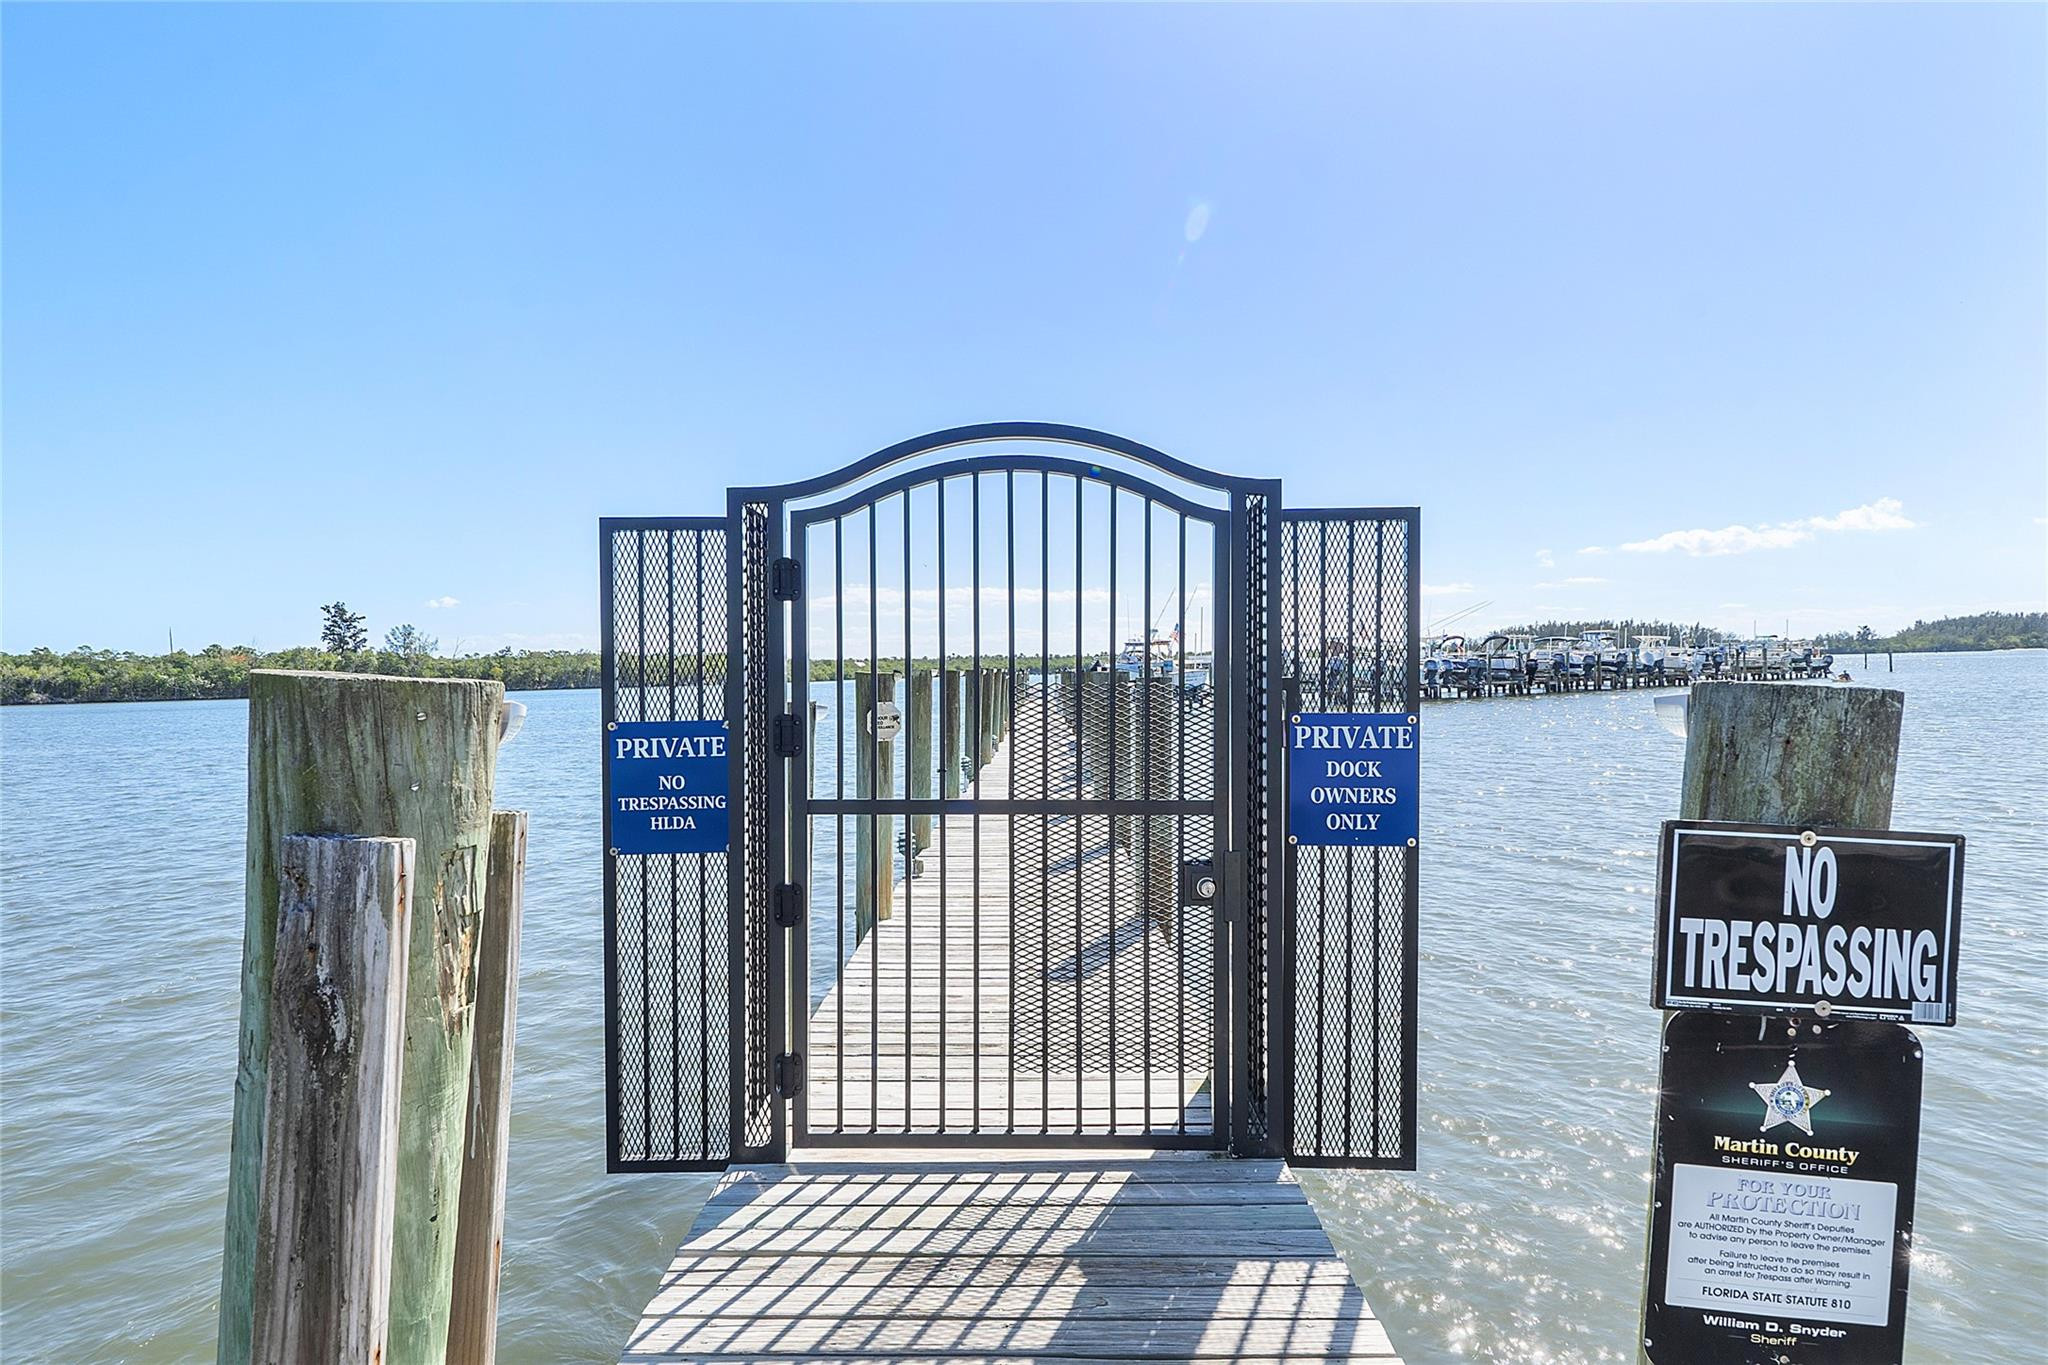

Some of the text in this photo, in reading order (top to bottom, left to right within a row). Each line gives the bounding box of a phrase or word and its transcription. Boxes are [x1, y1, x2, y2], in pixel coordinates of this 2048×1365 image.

[616, 736, 726, 759] PRIVATE
[1294, 725, 1414, 749] PRIVATE
[1326, 760, 1382, 778] DOCK
[658, 775, 685, 790] NO
[617, 795, 727, 811] TRESPASSING
[1310, 787, 1397, 805] OWNERS
[650, 816, 696, 831] HLDA
[1325, 813, 1381, 831] ONLY
[1783, 846, 1838, 919] NO
[1679, 917, 1938, 1002] TRESPASSING
[1714, 1136, 1860, 1166] Martin County
[1721, 1155, 1849, 1174] SHERIFF'S OFFICE
[1737, 1178, 1831, 1199] FOR YOUR
[1706, 1191, 1861, 1221] PROTECTION
[1709, 1213, 1855, 1234] All Martin County Sheriff's Deputies
[1689, 1231, 1698, 1239] to
[1700, 1233, 1728, 1242] advise
[1730, 1236, 1746, 1244] any
[1748, 1238, 1778, 1247] person
[1791, 1241, 1814, 1250] leave
[1816, 1243, 1830, 1251] the
[1832, 1246, 1872, 1255] premises.
[1694, 1222, 1744, 1233] AUTHORIZED
[1746, 1227, 1758, 1235] by
[1759, 1228, 1773, 1236] the
[1775, 1229, 1811, 1240] Property
[1813, 1232, 1886, 1247] Owner/Manager
[1687, 1256, 1707, 1264] after
[1709, 1258, 1735, 1269] being
[1736, 1261, 1778, 1272] instructed
[1780, 1265, 1789, 1273] to
[1790, 1266, 1803, 1274] do
[1816, 1269, 1836, 1278] may
[1838, 1271, 1861, 1279] result
[1863, 1272, 1871, 1280] in
[1719, 1250, 1840, 1268] Failure to leave the premises
[1718, 1269, 1742, 1277] arrest
[1744, 1271, 1756, 1279] for
[1757, 1272, 1792, 1282] Trespass
[1793, 1276, 1813, 1284] after
[1702, 1286, 1851, 1309] FLORIDA STATE STATUTE 810
[1703, 1314, 1847, 1339] William D. Snyder
[1750, 1333, 1798, 1346] Sheriff
